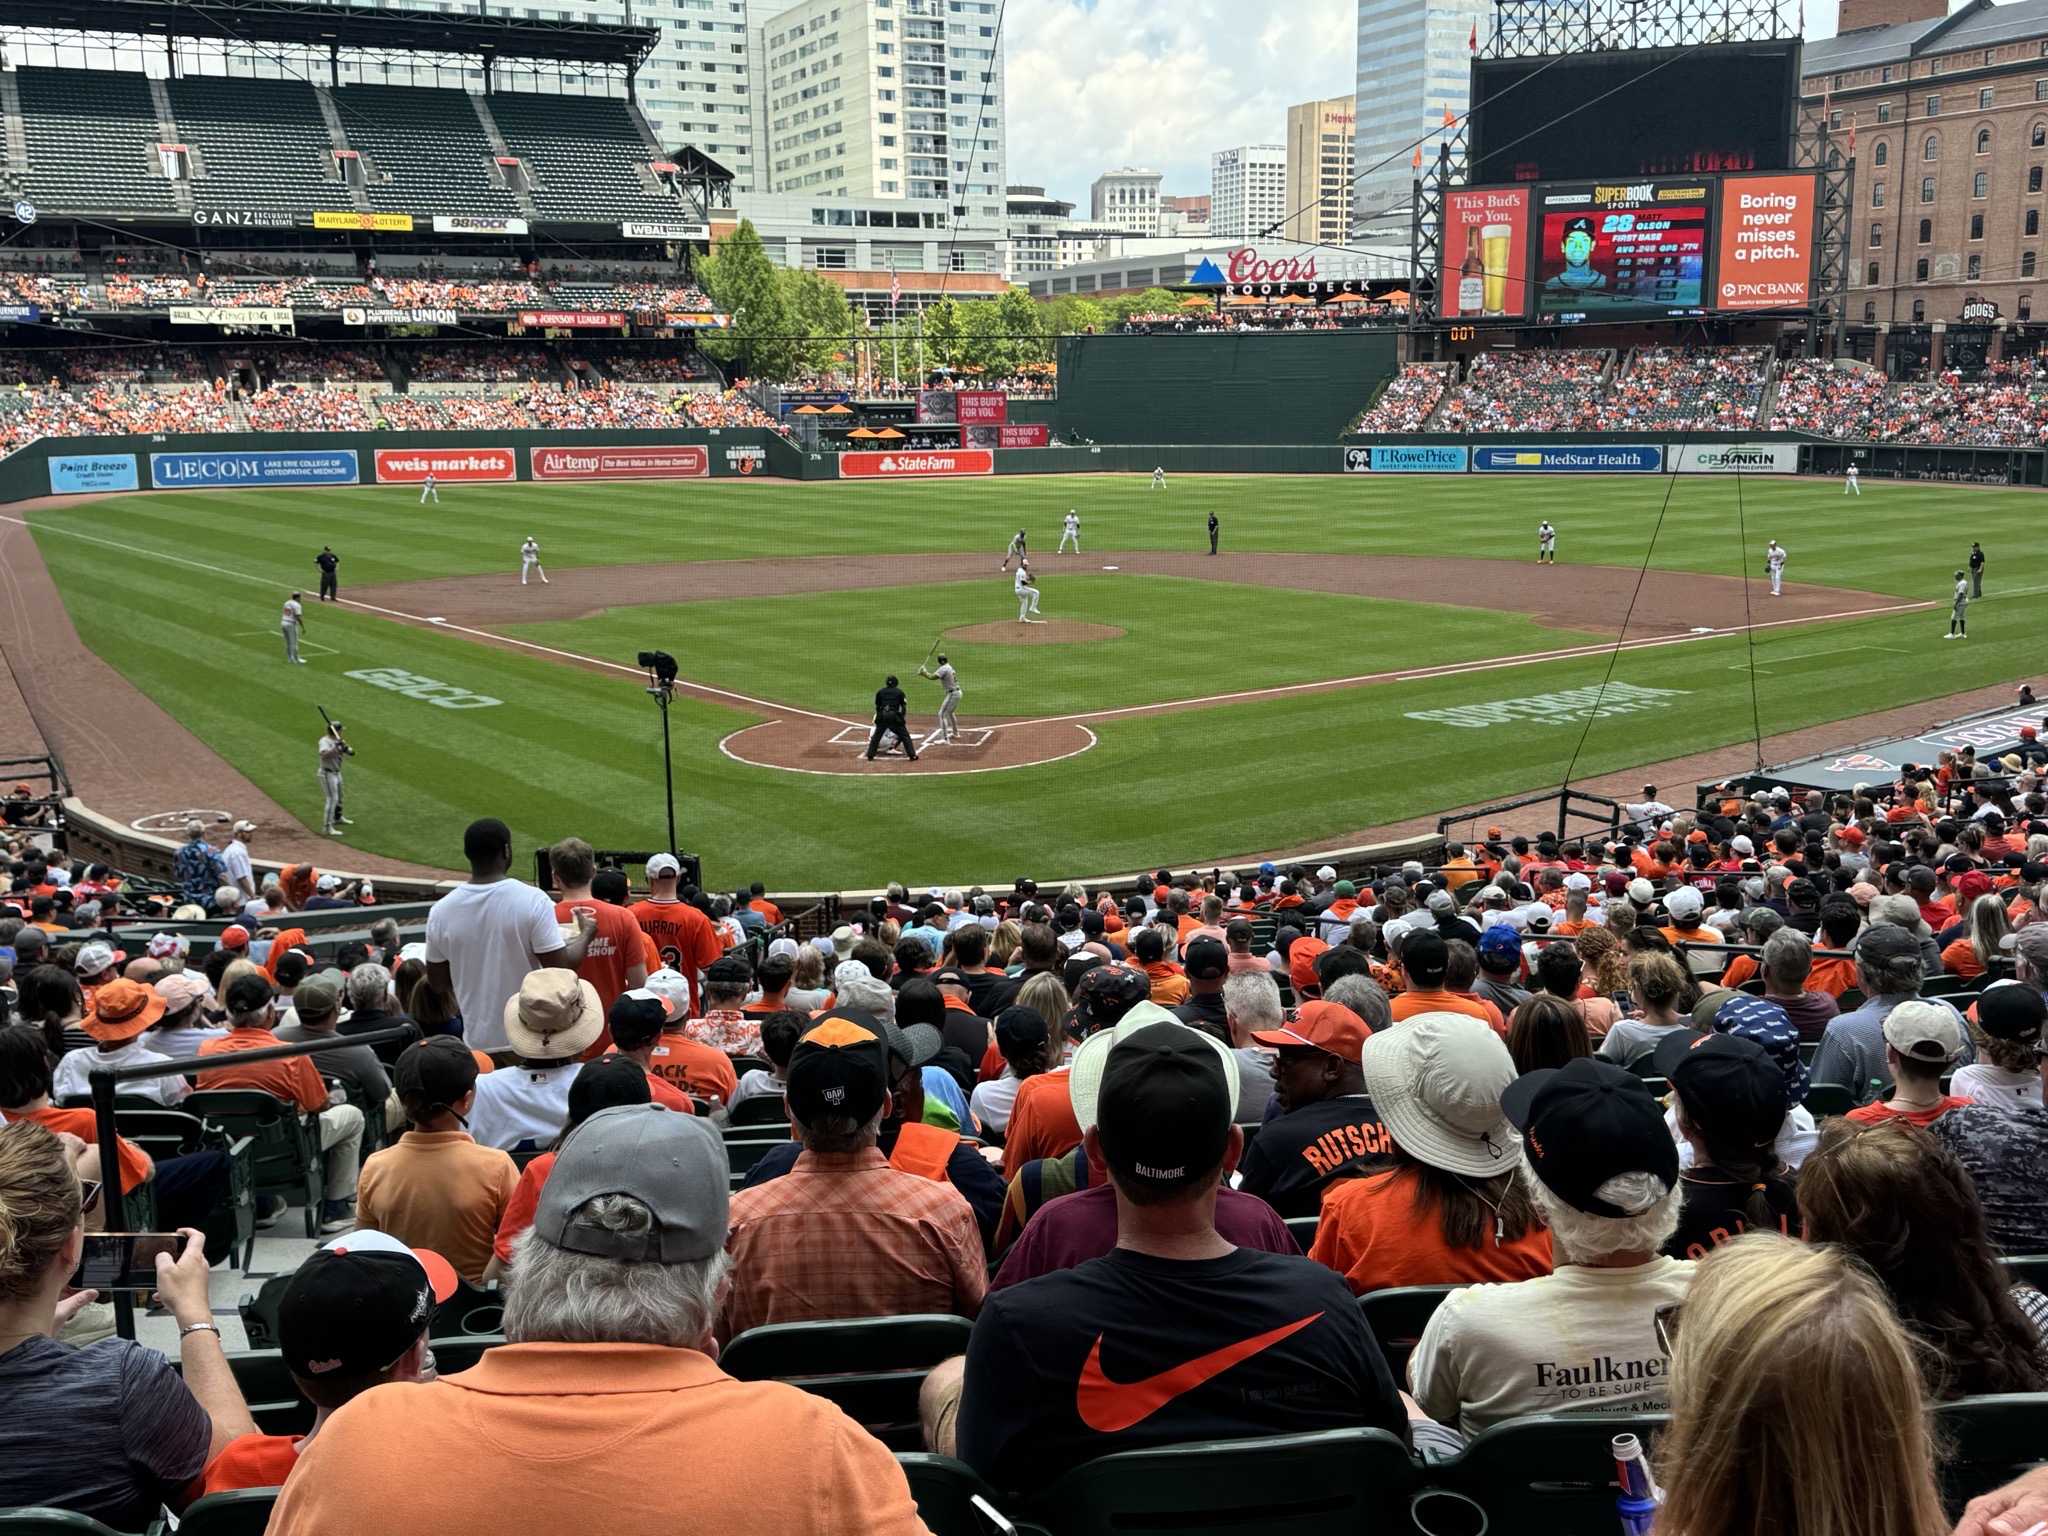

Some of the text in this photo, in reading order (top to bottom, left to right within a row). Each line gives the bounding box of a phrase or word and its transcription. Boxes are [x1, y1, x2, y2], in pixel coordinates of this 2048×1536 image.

[1595, 184, 1655, 204] SUPERBOOK
[1454, 194, 1520, 209] This Bud's
[1607, 201, 1640, 210] SPORTS
[1740, 192, 1797, 210] Boring
[18, 205, 33, 219] 42
[193, 210, 253, 225] GANZ
[254, 211, 293, 219] EXCLUSIVE
[1461, 210, 1512, 224] For You.
[1637, 213, 1663, 221] MATT
[271, 219, 293, 227] ESTATE
[319, 216, 359, 225] MARYLAND
[1602, 213, 1636, 234] 28
[1636, 220, 1671, 231] OLSON
[1742, 213, 1793, 226] never
[632, 225, 667, 236] WBAL
[1737, 227, 1796, 243] misses
[1611, 232, 1663, 243] FIRST BASE
[1615, 245, 1635, 254] AVG
[1659, 244, 1679, 252] OPS
[1680, 243, 1699, 251] .774
[1734, 244, 1800, 263] a pitch.
[1227, 247, 1410, 283] Coors LIGHT
[1225, 280, 1370, 296] ROOF DECK
[1737, 282, 1805, 296] PNC BANK
[273, 312, 291, 320] LOCAL
[411, 309, 457, 322] UNION
[1964, 303, 1995, 320] BOOG'S
[539, 314, 607, 325] JOHNSON LUMBER
[961, 396, 1004, 407] THIS BUD'S
[961, 407, 997, 418] FOR YOU.
[1002, 427, 1040, 436] THIS BUD'S
[152, 434, 166, 442] 384
[1002, 437, 1033, 446] FOR YOU.
[726, 450, 766, 459] CHAMPIONS
[1543, 453, 1641, 465] MedStar Health
[1721, 454, 1775, 465] RANKIN
[91, 461, 128, 472] Breeze
[263, 460, 283, 468] LAKE
[331, 459, 341, 467] OF
[386, 456, 506, 472] weis markets
[544, 453, 599, 472] Airtemp
[604, 459, 616, 467] The
[615, 459, 630, 467] Best
[630, 459, 647, 467] Value
[671, 458, 695, 466] Comfort
[264, 467, 347, 476] OSTEOPATHIC MEDICINE
[343, 668, 505, 709] GEICO
[1403, 681, 1694, 728] SUPERBOOK
[1531, 699, 1673, 725] SPORTS
[587, 945, 617, 957] SHOW
[1135, 1161, 1185, 1179] BALTIMORE
[1561, 1380, 1651, 1399] TO BE SURE
[1630, 1403, 1639, 1412] &
